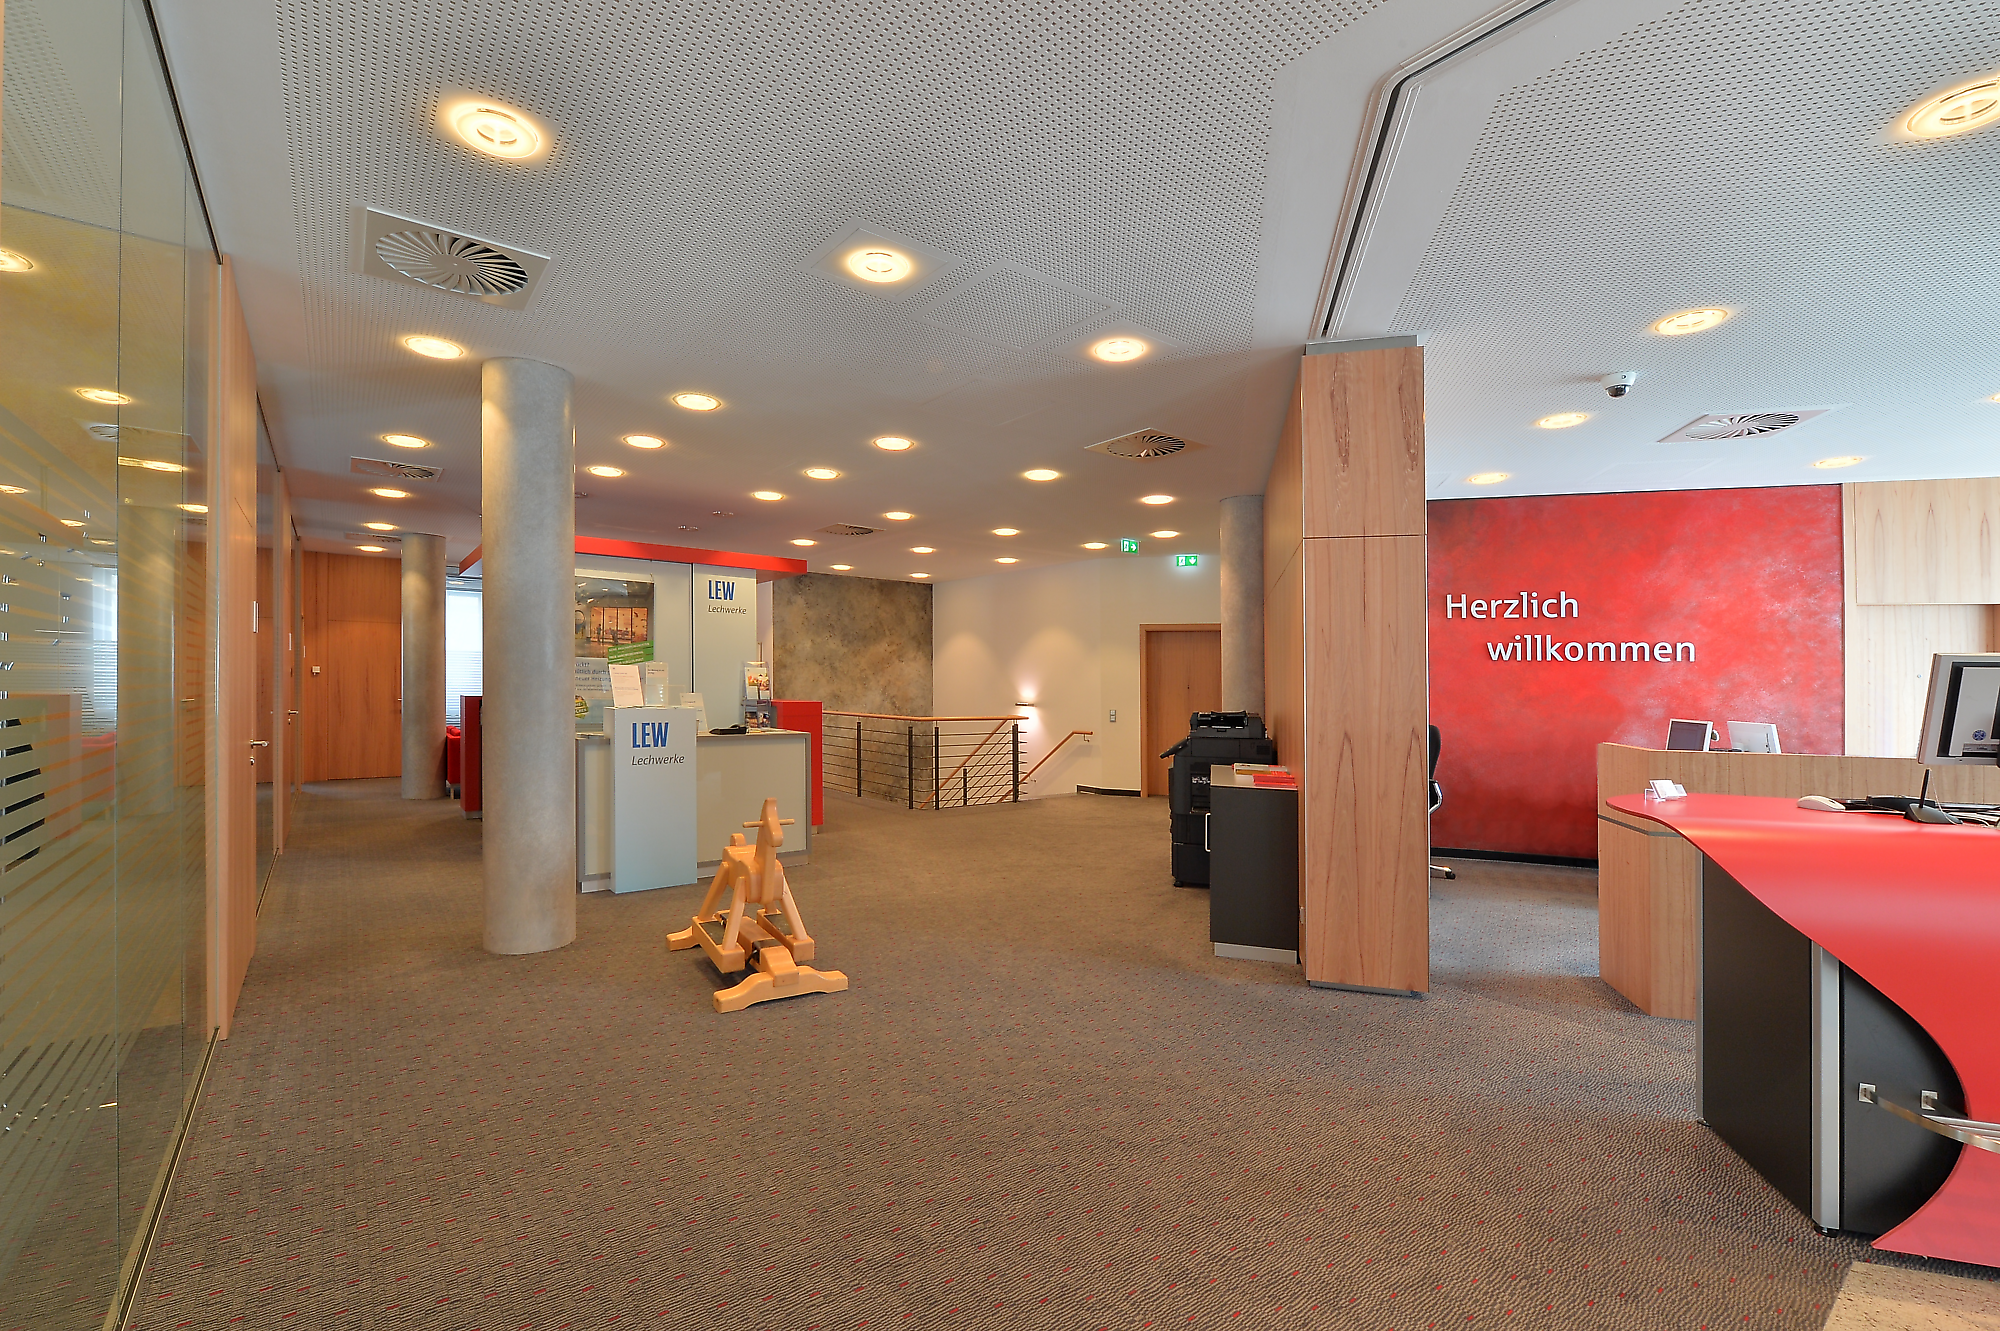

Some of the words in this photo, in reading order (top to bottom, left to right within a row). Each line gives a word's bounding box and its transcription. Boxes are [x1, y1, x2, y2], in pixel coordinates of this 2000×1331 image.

[708, 579, 735, 601] LEW
[708, 604, 747, 615] Lechwerke
[1446, 591, 1579, 619] Herzlich
[1487, 634, 1697, 662] willkommen
[632, 721, 669, 748] LEW
[631, 753, 685, 766] Lechwerke
